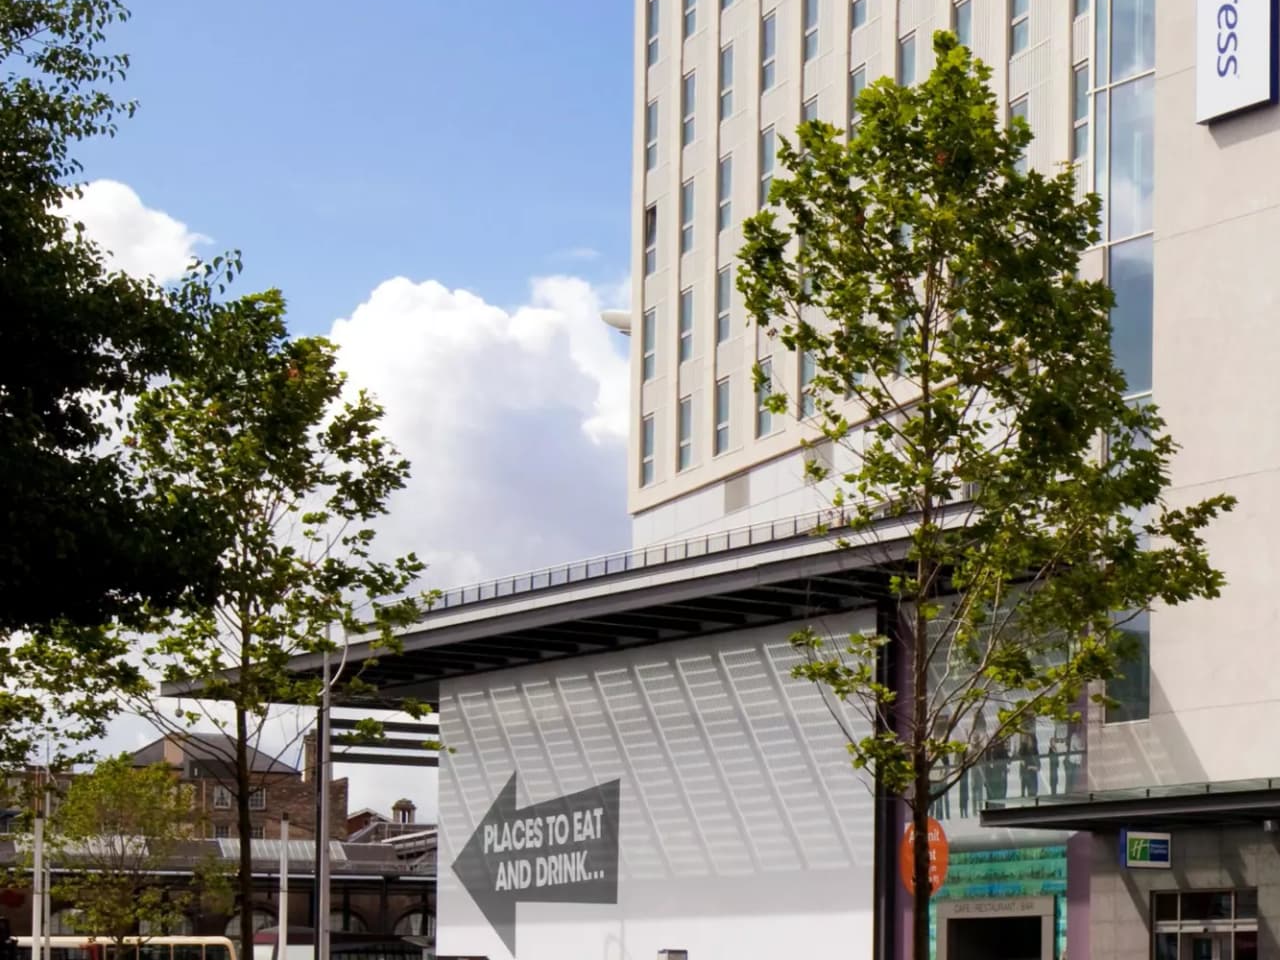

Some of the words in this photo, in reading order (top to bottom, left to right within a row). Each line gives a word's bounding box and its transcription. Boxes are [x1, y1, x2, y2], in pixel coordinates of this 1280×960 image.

[483, 817, 543, 854] PLACES
[546, 813, 569, 846] TO
[573, 808, 603, 842] EAT
[495, 860, 531, 891] AND
[535, 850, 604, 887] DRINK...
